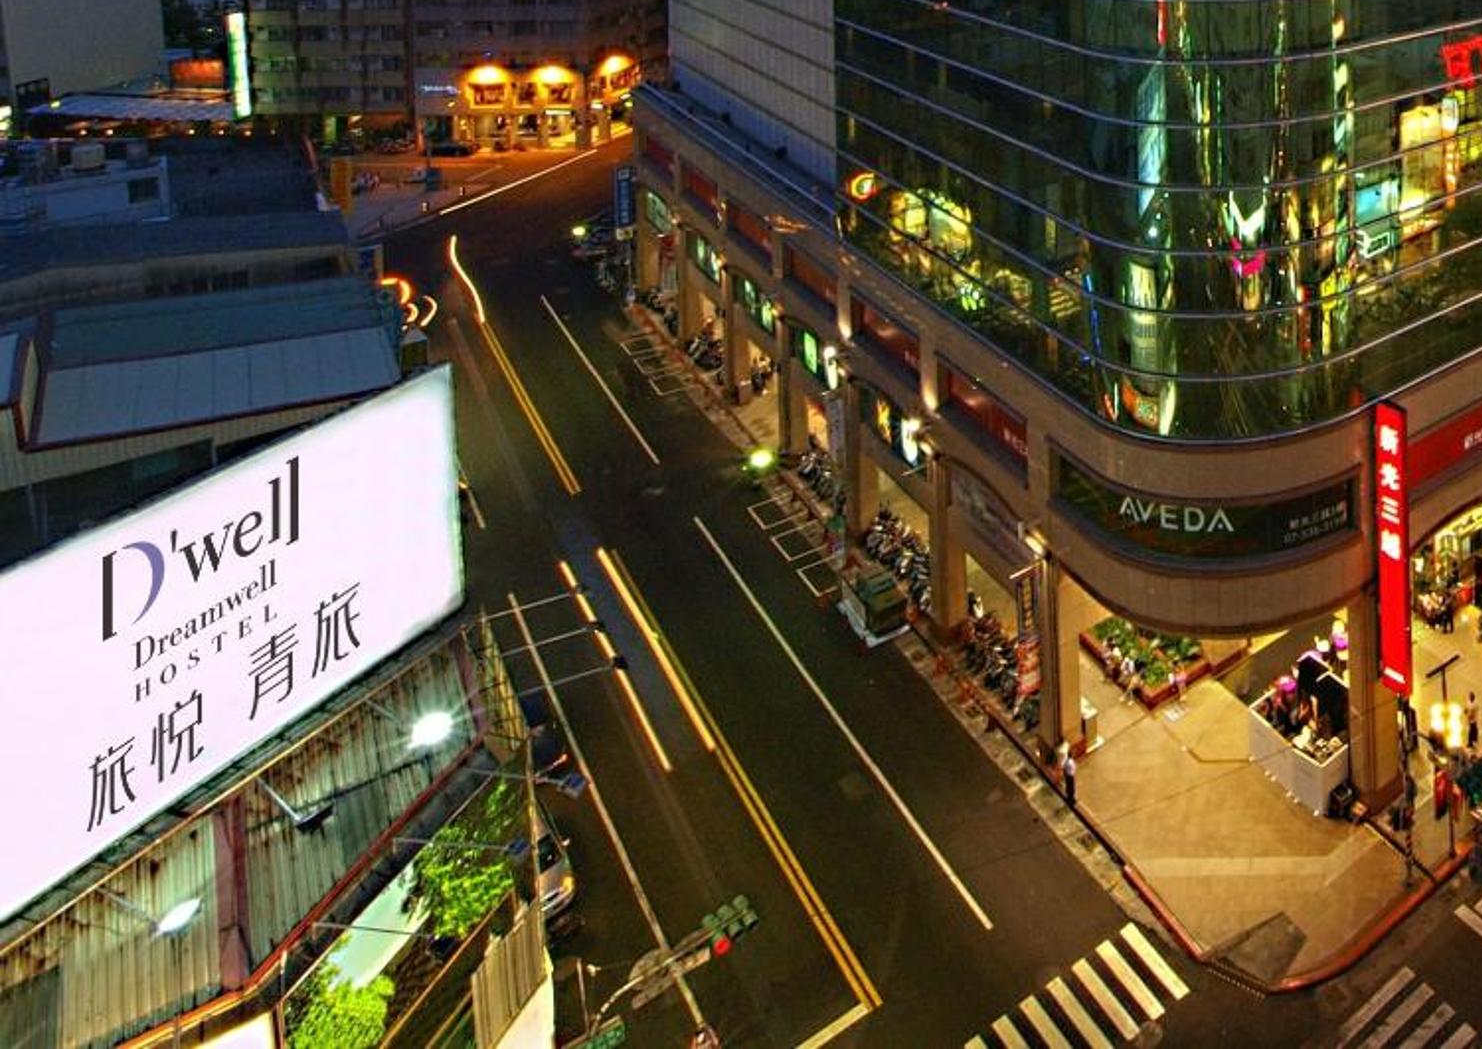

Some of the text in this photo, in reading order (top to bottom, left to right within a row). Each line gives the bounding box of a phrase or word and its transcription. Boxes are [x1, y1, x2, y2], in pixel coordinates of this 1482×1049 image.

[101, 456, 301, 642] D'well
[1119, 496, 1235, 533] AVEDA
[134, 558, 279, 671] Dreamwell
[134, 606, 281, 703] HOSTEL
